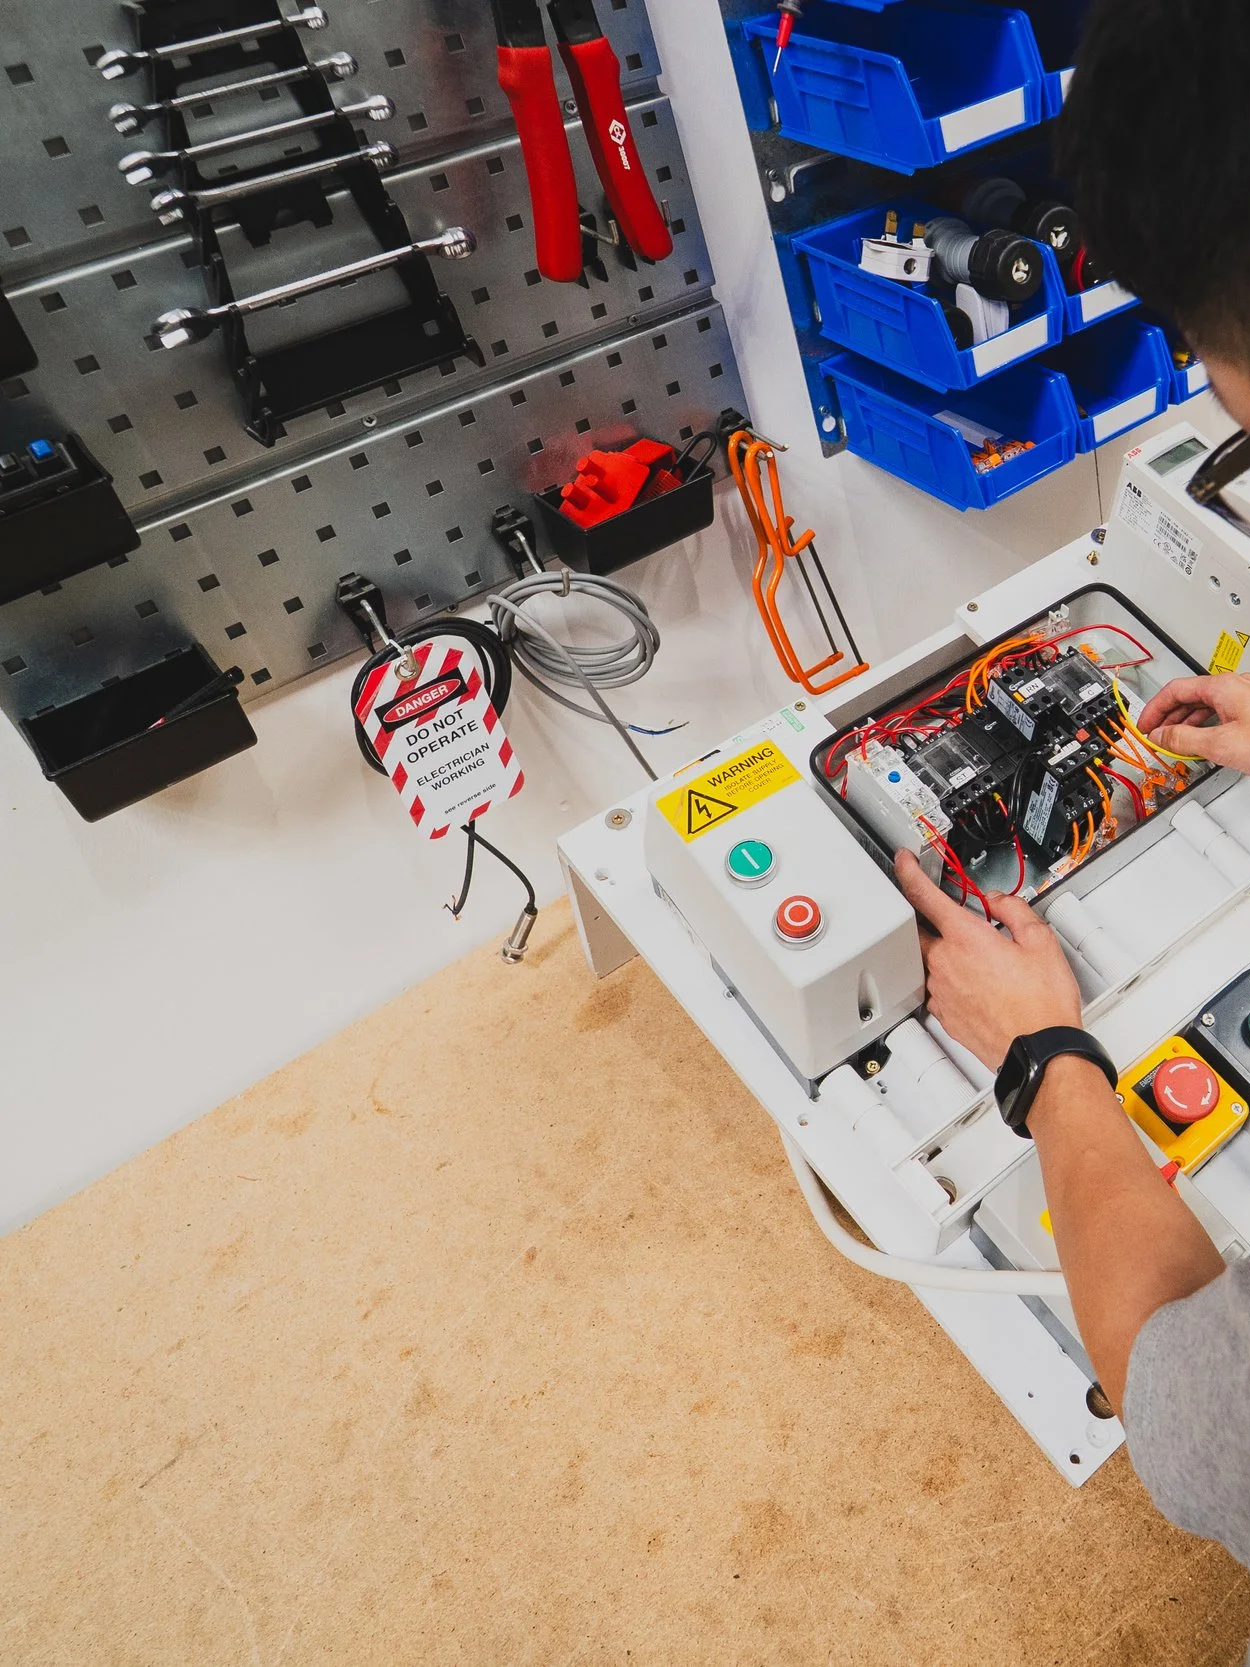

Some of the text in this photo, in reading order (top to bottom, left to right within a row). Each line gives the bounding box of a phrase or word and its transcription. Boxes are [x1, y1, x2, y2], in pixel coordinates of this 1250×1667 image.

[1126, 482, 1142, 498] ABB
[395, 685, 449, 717] DANGER
[1026, 682, 1039, 694] RN
[1088, 686, 1094, 696] C
[406, 709, 463, 747] DO NOT
[407, 720, 479, 764] OPERATE
[416, 742, 490, 786] ELECTRICIAN
[431, 758, 486, 790] WORKING
[708, 748, 774, 788] WARNING
[724, 758, 777, 790] ISOLATE SUPPLY
[726, 780, 754, 798] BEFORE
[755, 763, 784, 782] OPENING
[748, 778, 772, 793] COVER
[444, 782, 497, 815] see reverse side
